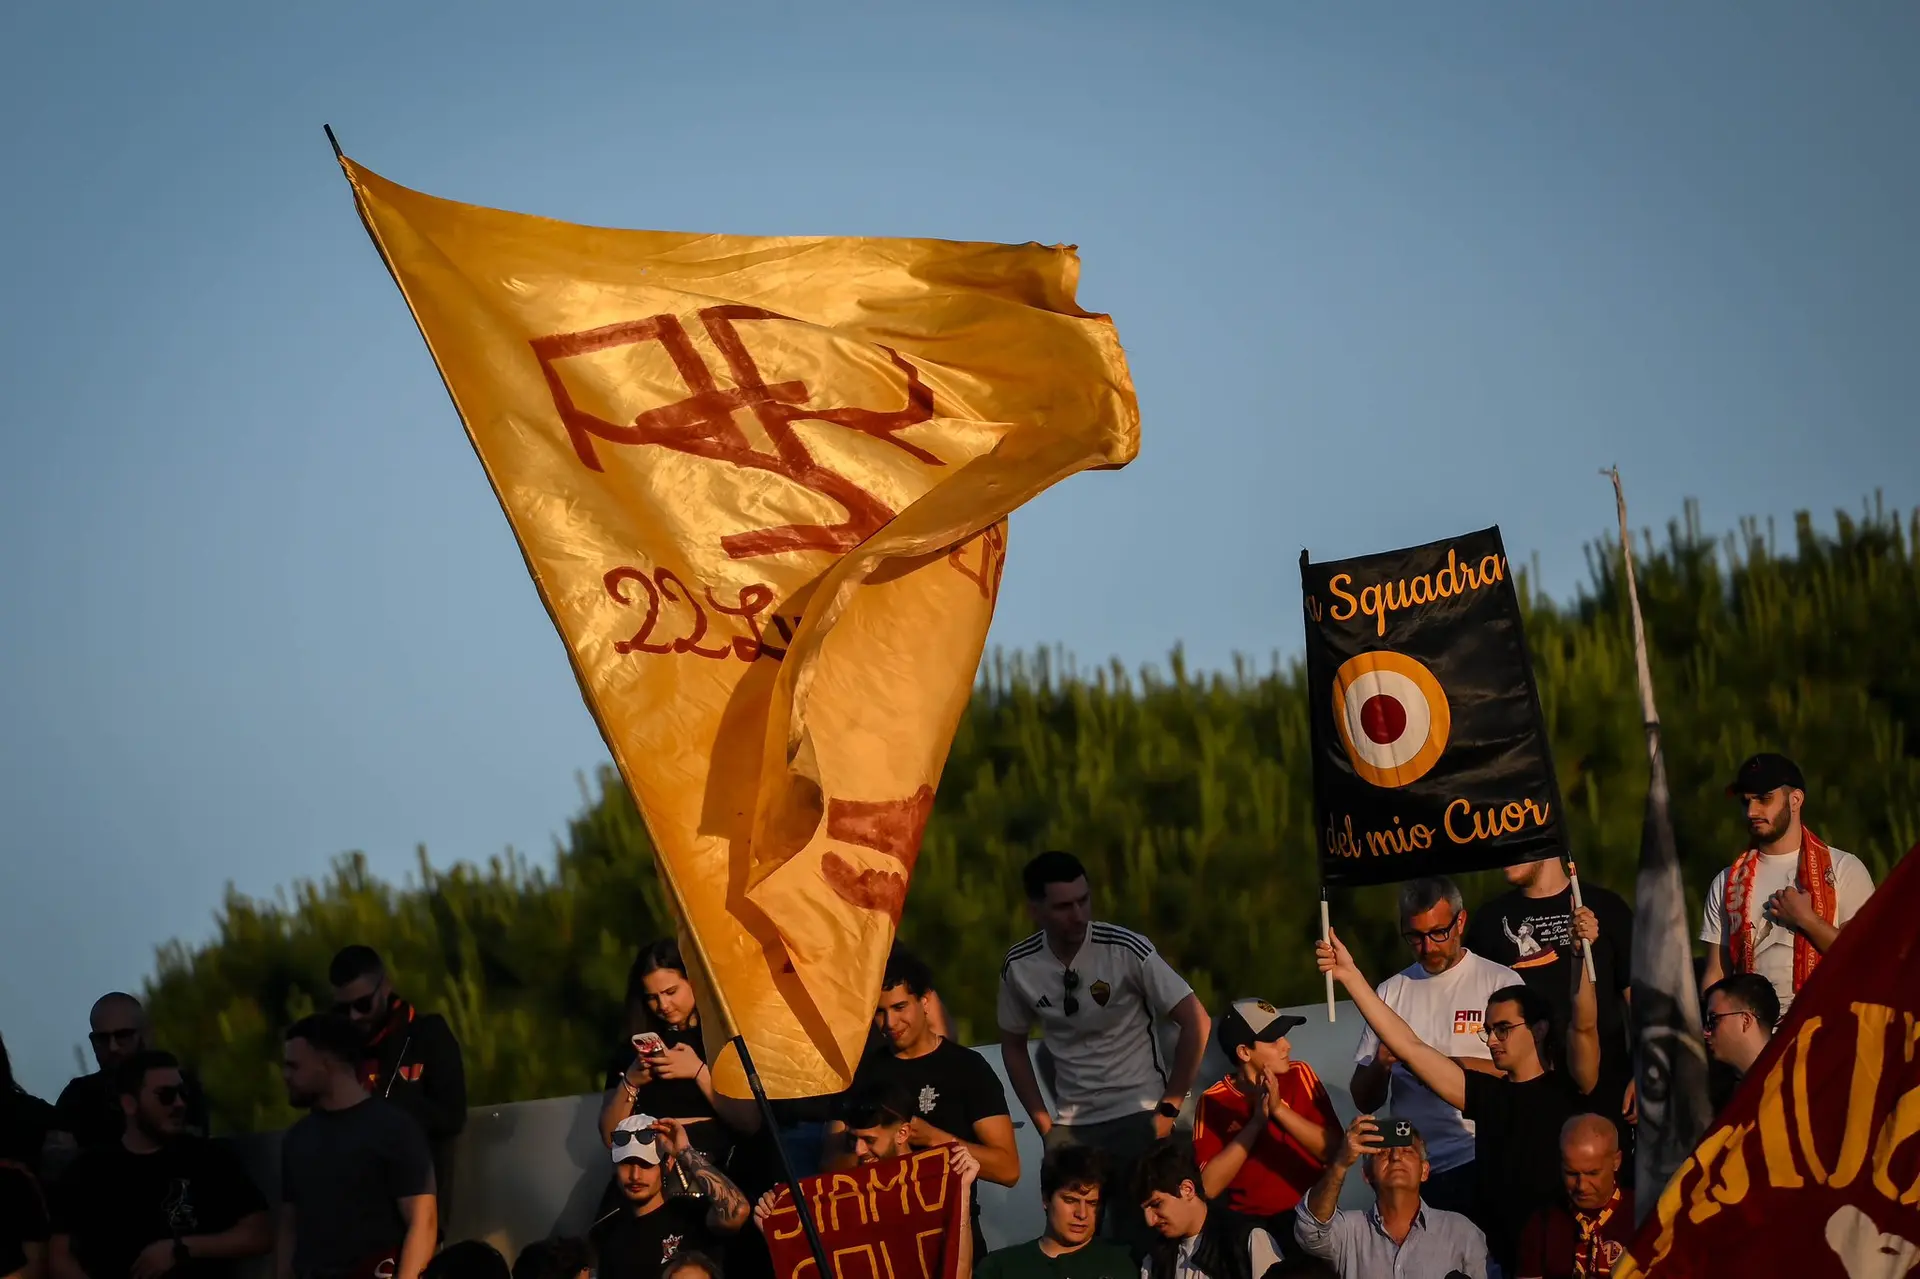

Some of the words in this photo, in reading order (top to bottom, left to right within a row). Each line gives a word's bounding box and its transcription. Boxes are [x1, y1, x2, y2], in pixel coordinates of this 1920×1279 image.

[1328, 548, 1506, 637] Squadra
[1326, 813, 1362, 859] del
[1366, 815, 1437, 857] mio
[1443, 797, 1550, 845] Cuor
[769, 1146, 950, 1241] SIAMO
